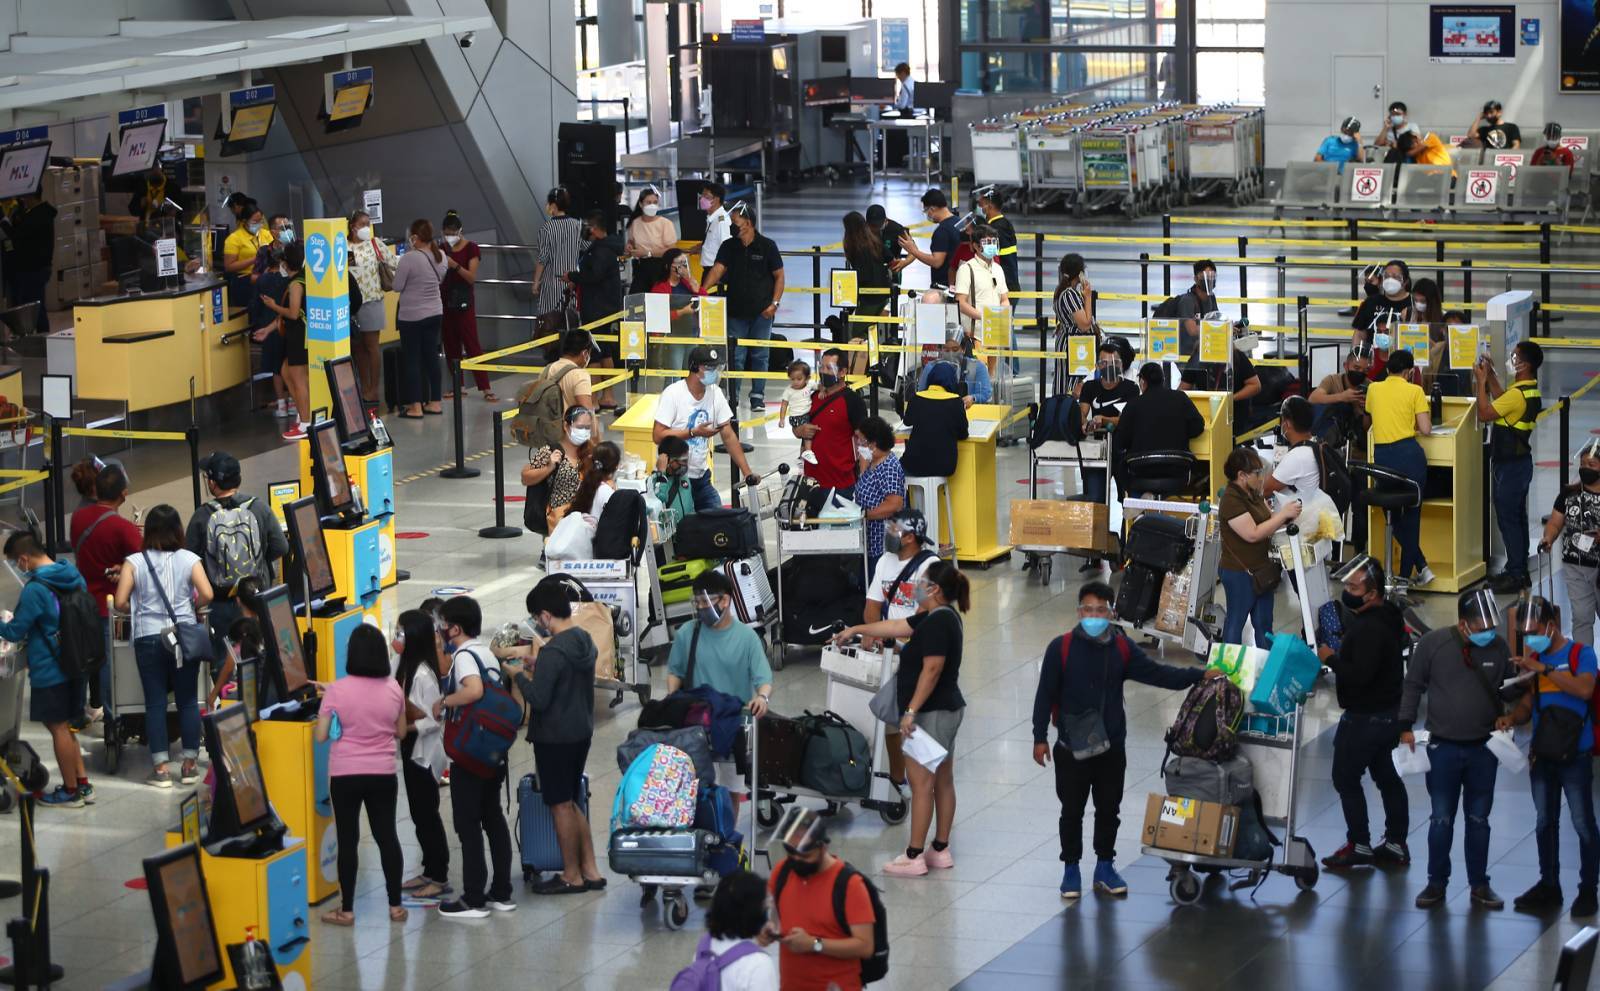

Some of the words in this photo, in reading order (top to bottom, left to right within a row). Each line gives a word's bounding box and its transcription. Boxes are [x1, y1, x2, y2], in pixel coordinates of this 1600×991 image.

[135, 110, 140, 119] D
[140, 109, 148, 118] 03
[16, 131, 21, 140] D
[310, 236, 325, 249] Step
[312, 248, 324, 273] 2
[337, 247, 344, 271] 2
[309, 307, 332, 321] SELF
[336, 305, 349, 321] SELF
